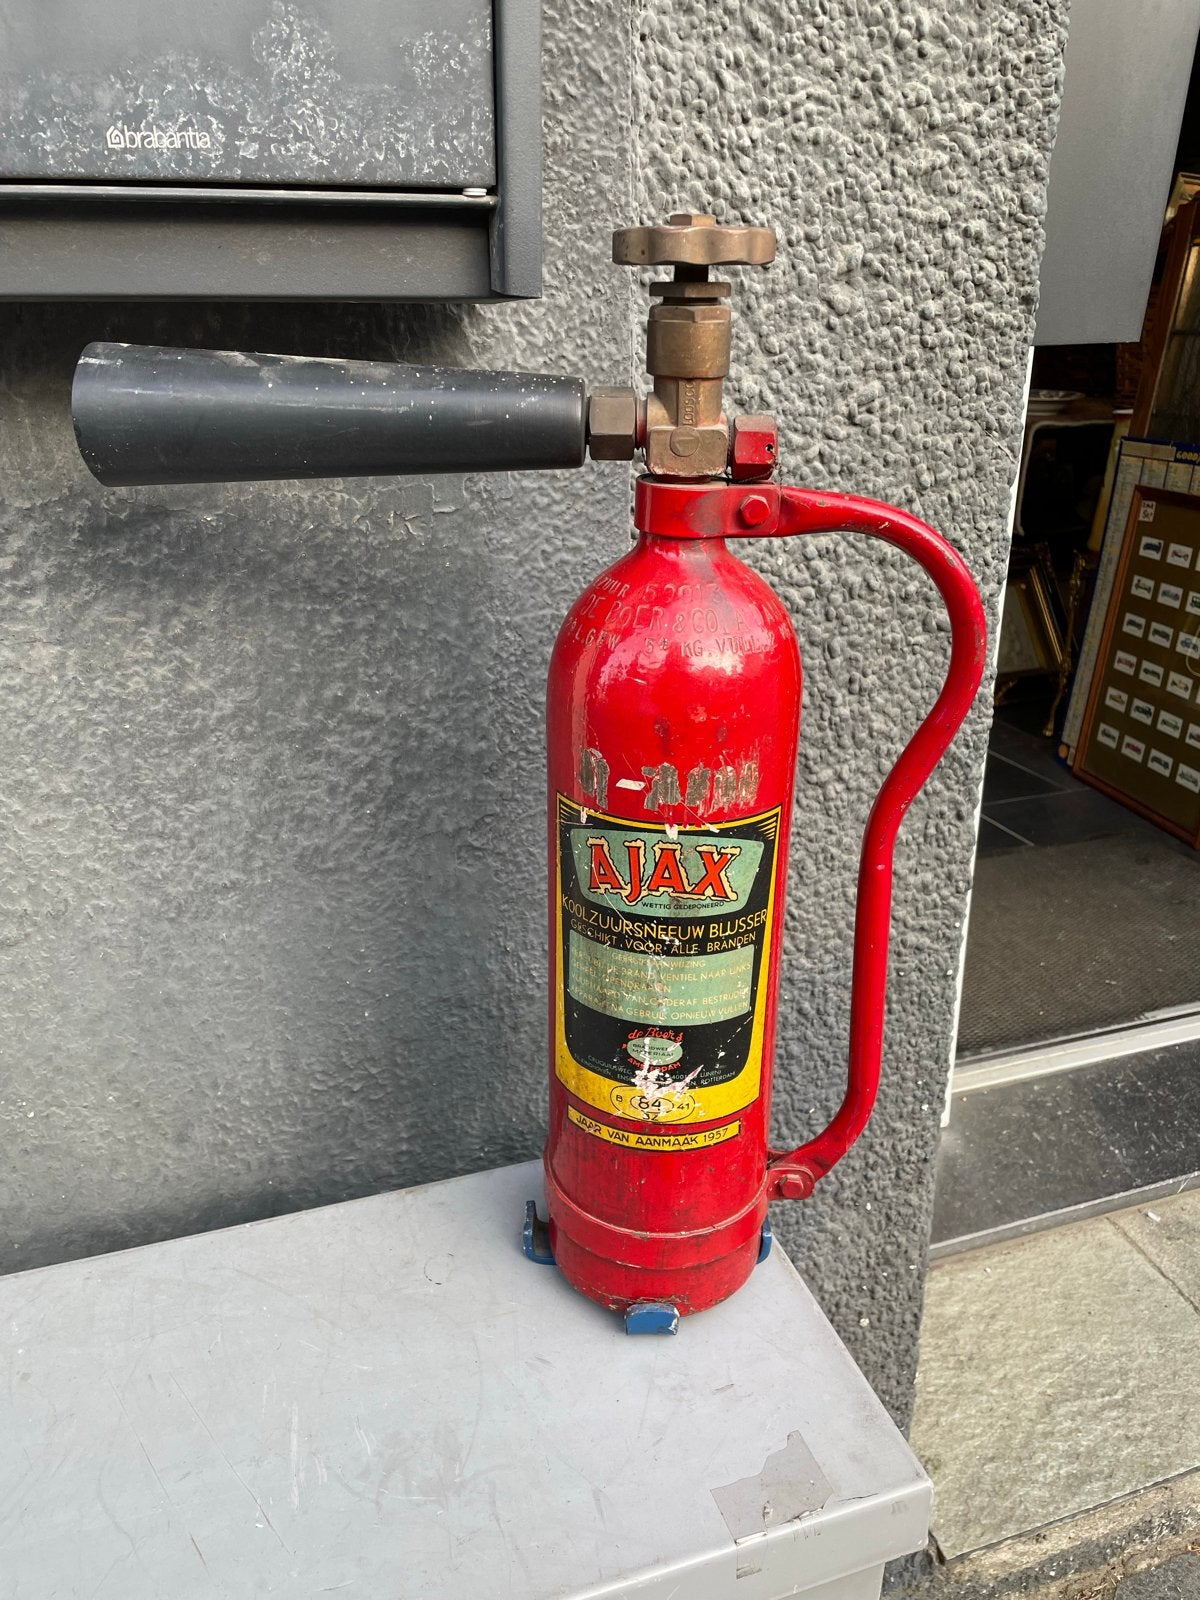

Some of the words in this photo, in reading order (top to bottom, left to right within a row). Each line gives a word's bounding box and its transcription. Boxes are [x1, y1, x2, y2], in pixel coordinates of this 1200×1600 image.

[124, 124, 211, 149] brabantia
[672, 612, 687, 633] &
[586, 836, 742, 906] AJAX
[641, 901, 671, 910] WETTIG
[673, 901, 725, 910] GEDEPONEERD
[562, 893, 705, 940] KOOLZUURSNEEUW
[709, 908, 767, 938] BLUSSER
[570, 918, 618, 945] GESCHIKT
[625, 939, 663, 953] VOOR
[671, 943, 699, 954] ALLE
[707, 932, 756, 952] BRANDEN
[660, 973, 698, 981] VENTIEL
[700, 969, 727, 981] NAAR
[729, 962, 752, 975] LINKS
[670, 1009, 716, 1020] OPNIEUW
[627, 1057, 682, 1072] AMSERDAM
[615, 1094, 623, 1103] B
[676, 1102, 690, 1111] 41
[607, 1129, 630, 1143] VAN
[635, 1136, 699, 1148] AANMAAK
[703, 1128, 728, 1143] 1957
